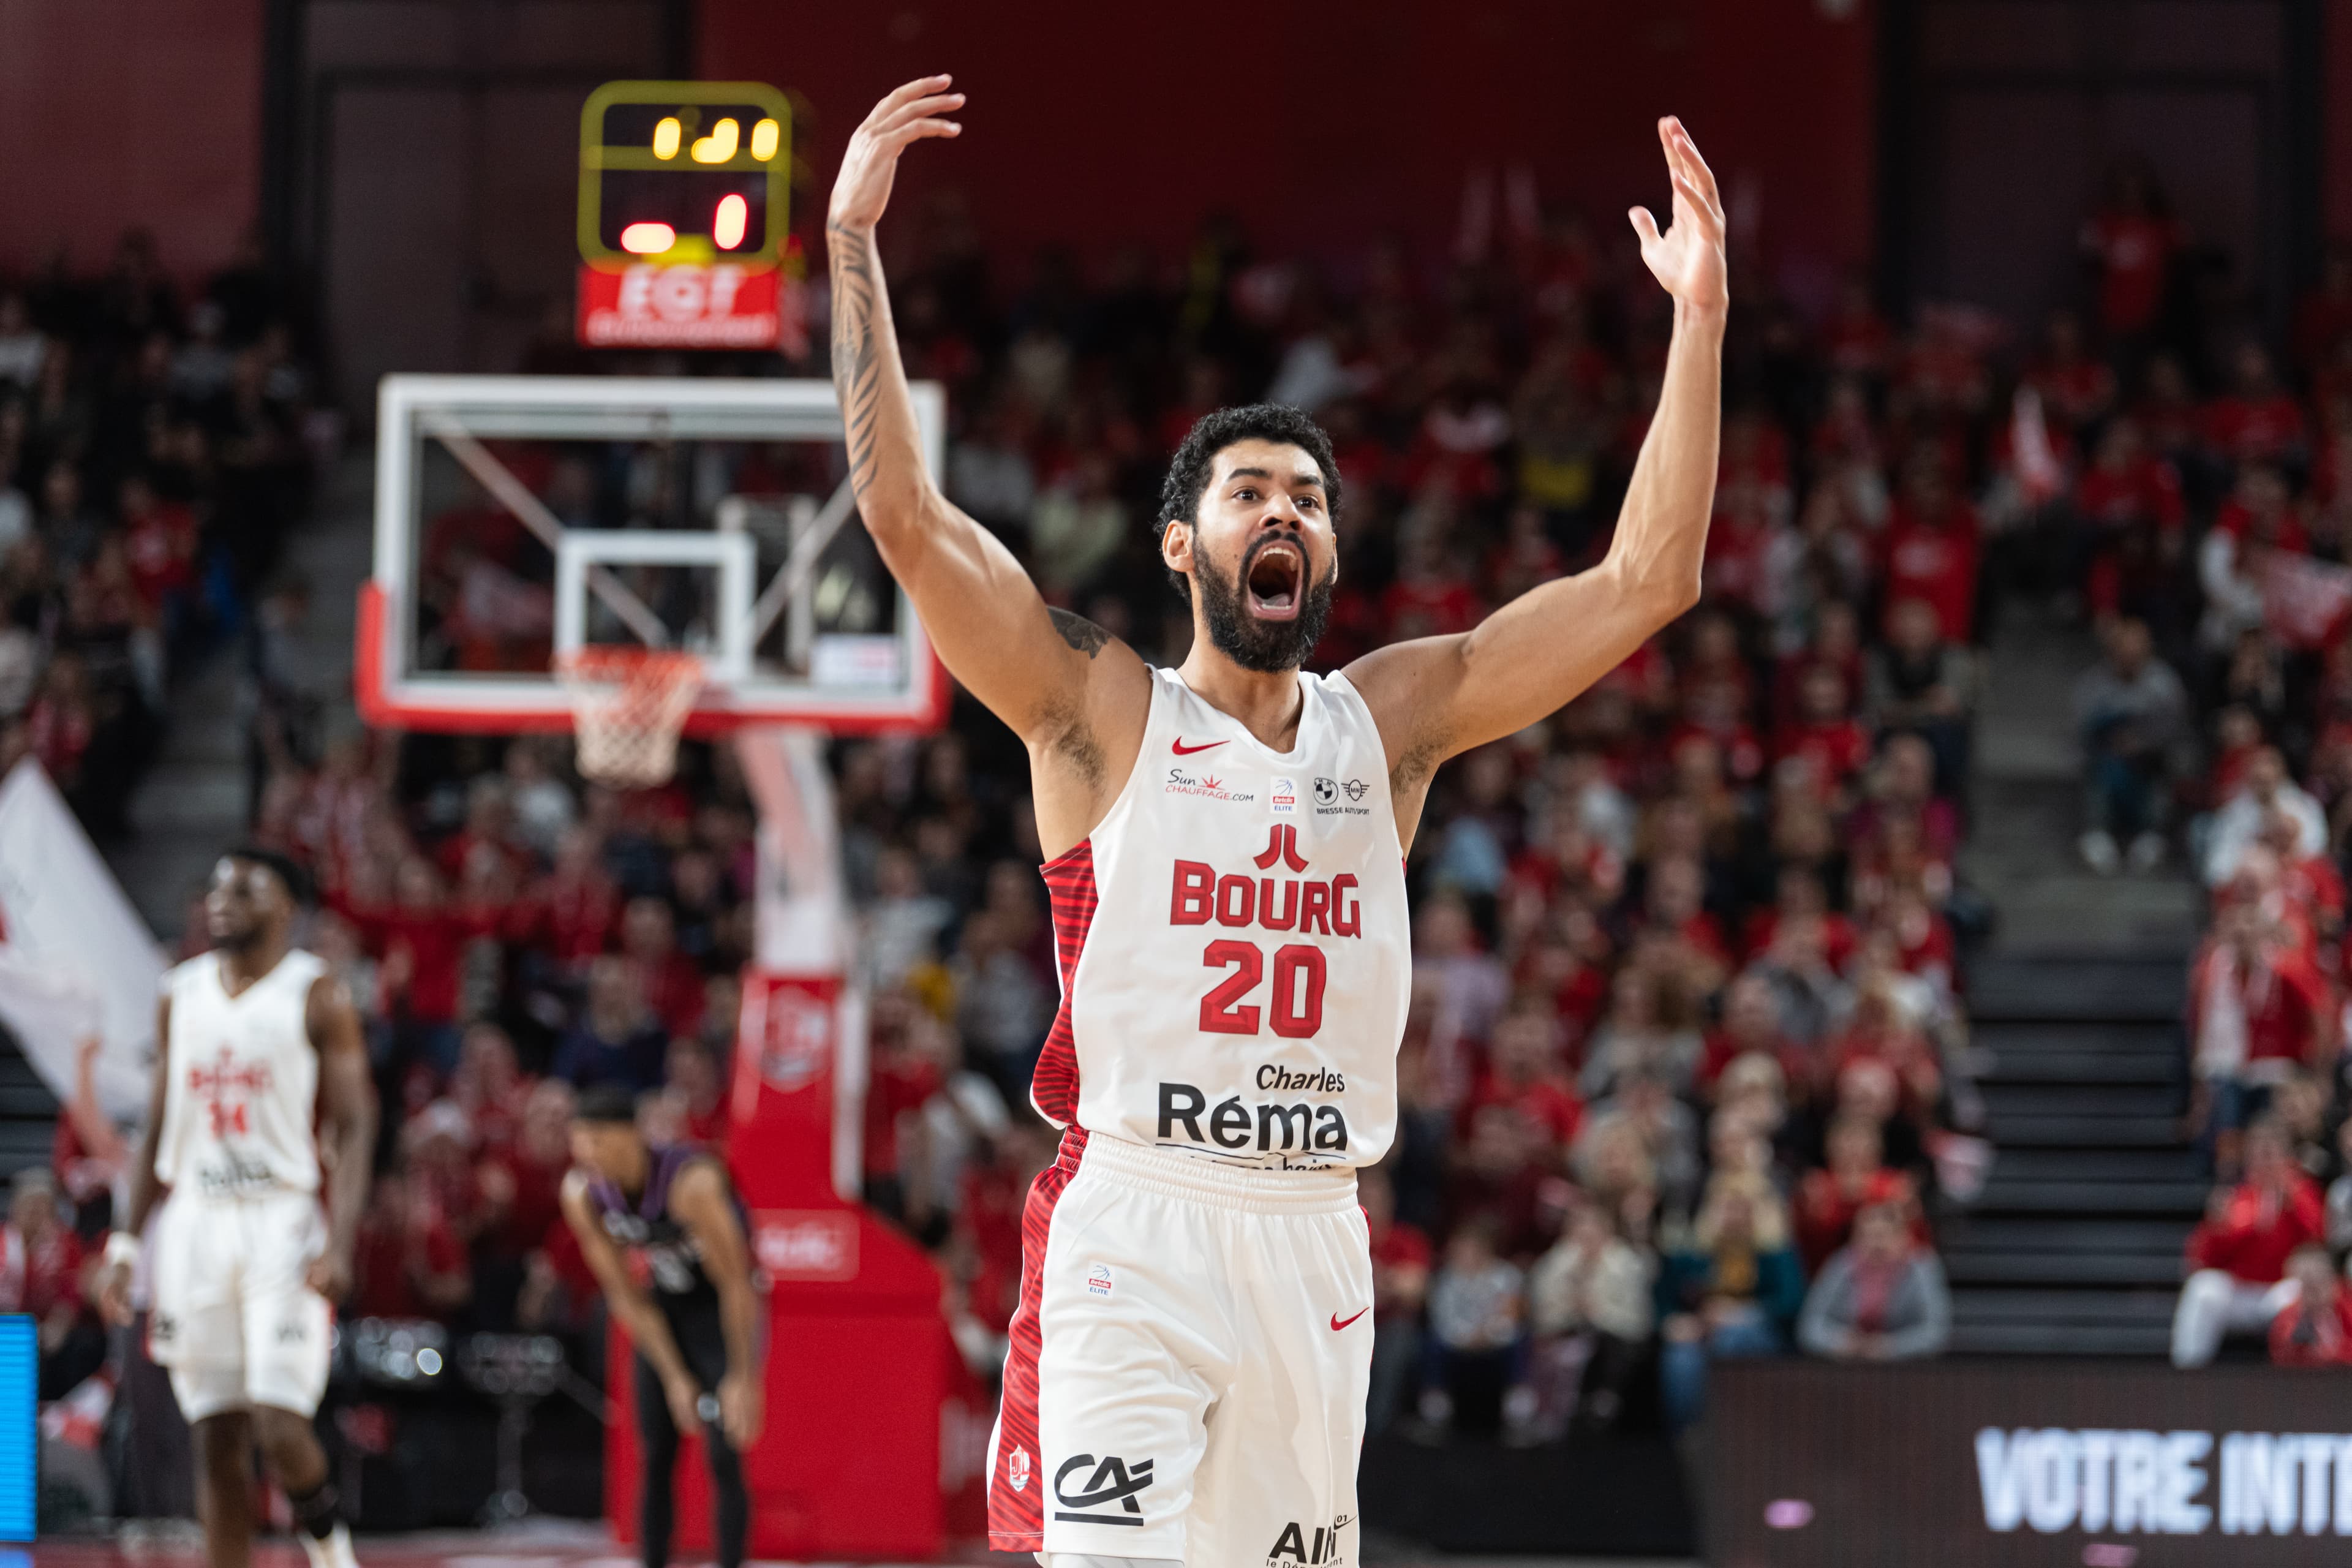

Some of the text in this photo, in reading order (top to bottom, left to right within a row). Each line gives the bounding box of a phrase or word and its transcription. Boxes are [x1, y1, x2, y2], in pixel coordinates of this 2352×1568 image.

[1166, 785, 1254, 802] CHAUFFAGE.COM
[1167, 769, 1196, 786] Sun
[1170, 859, 1361, 939] BOURG
[1199, 940, 1327, 1039] 20
[1257, 1065, 1345, 1093] Charles
[1158, 1083, 1348, 1152] Réma
[1090, 1287, 1108, 1295] ÉLITE
[1975, 1427, 2214, 1534] VOTRE
[1268, 1522, 1336, 1564] AIN
[1266, 1558, 1276, 1568] le
